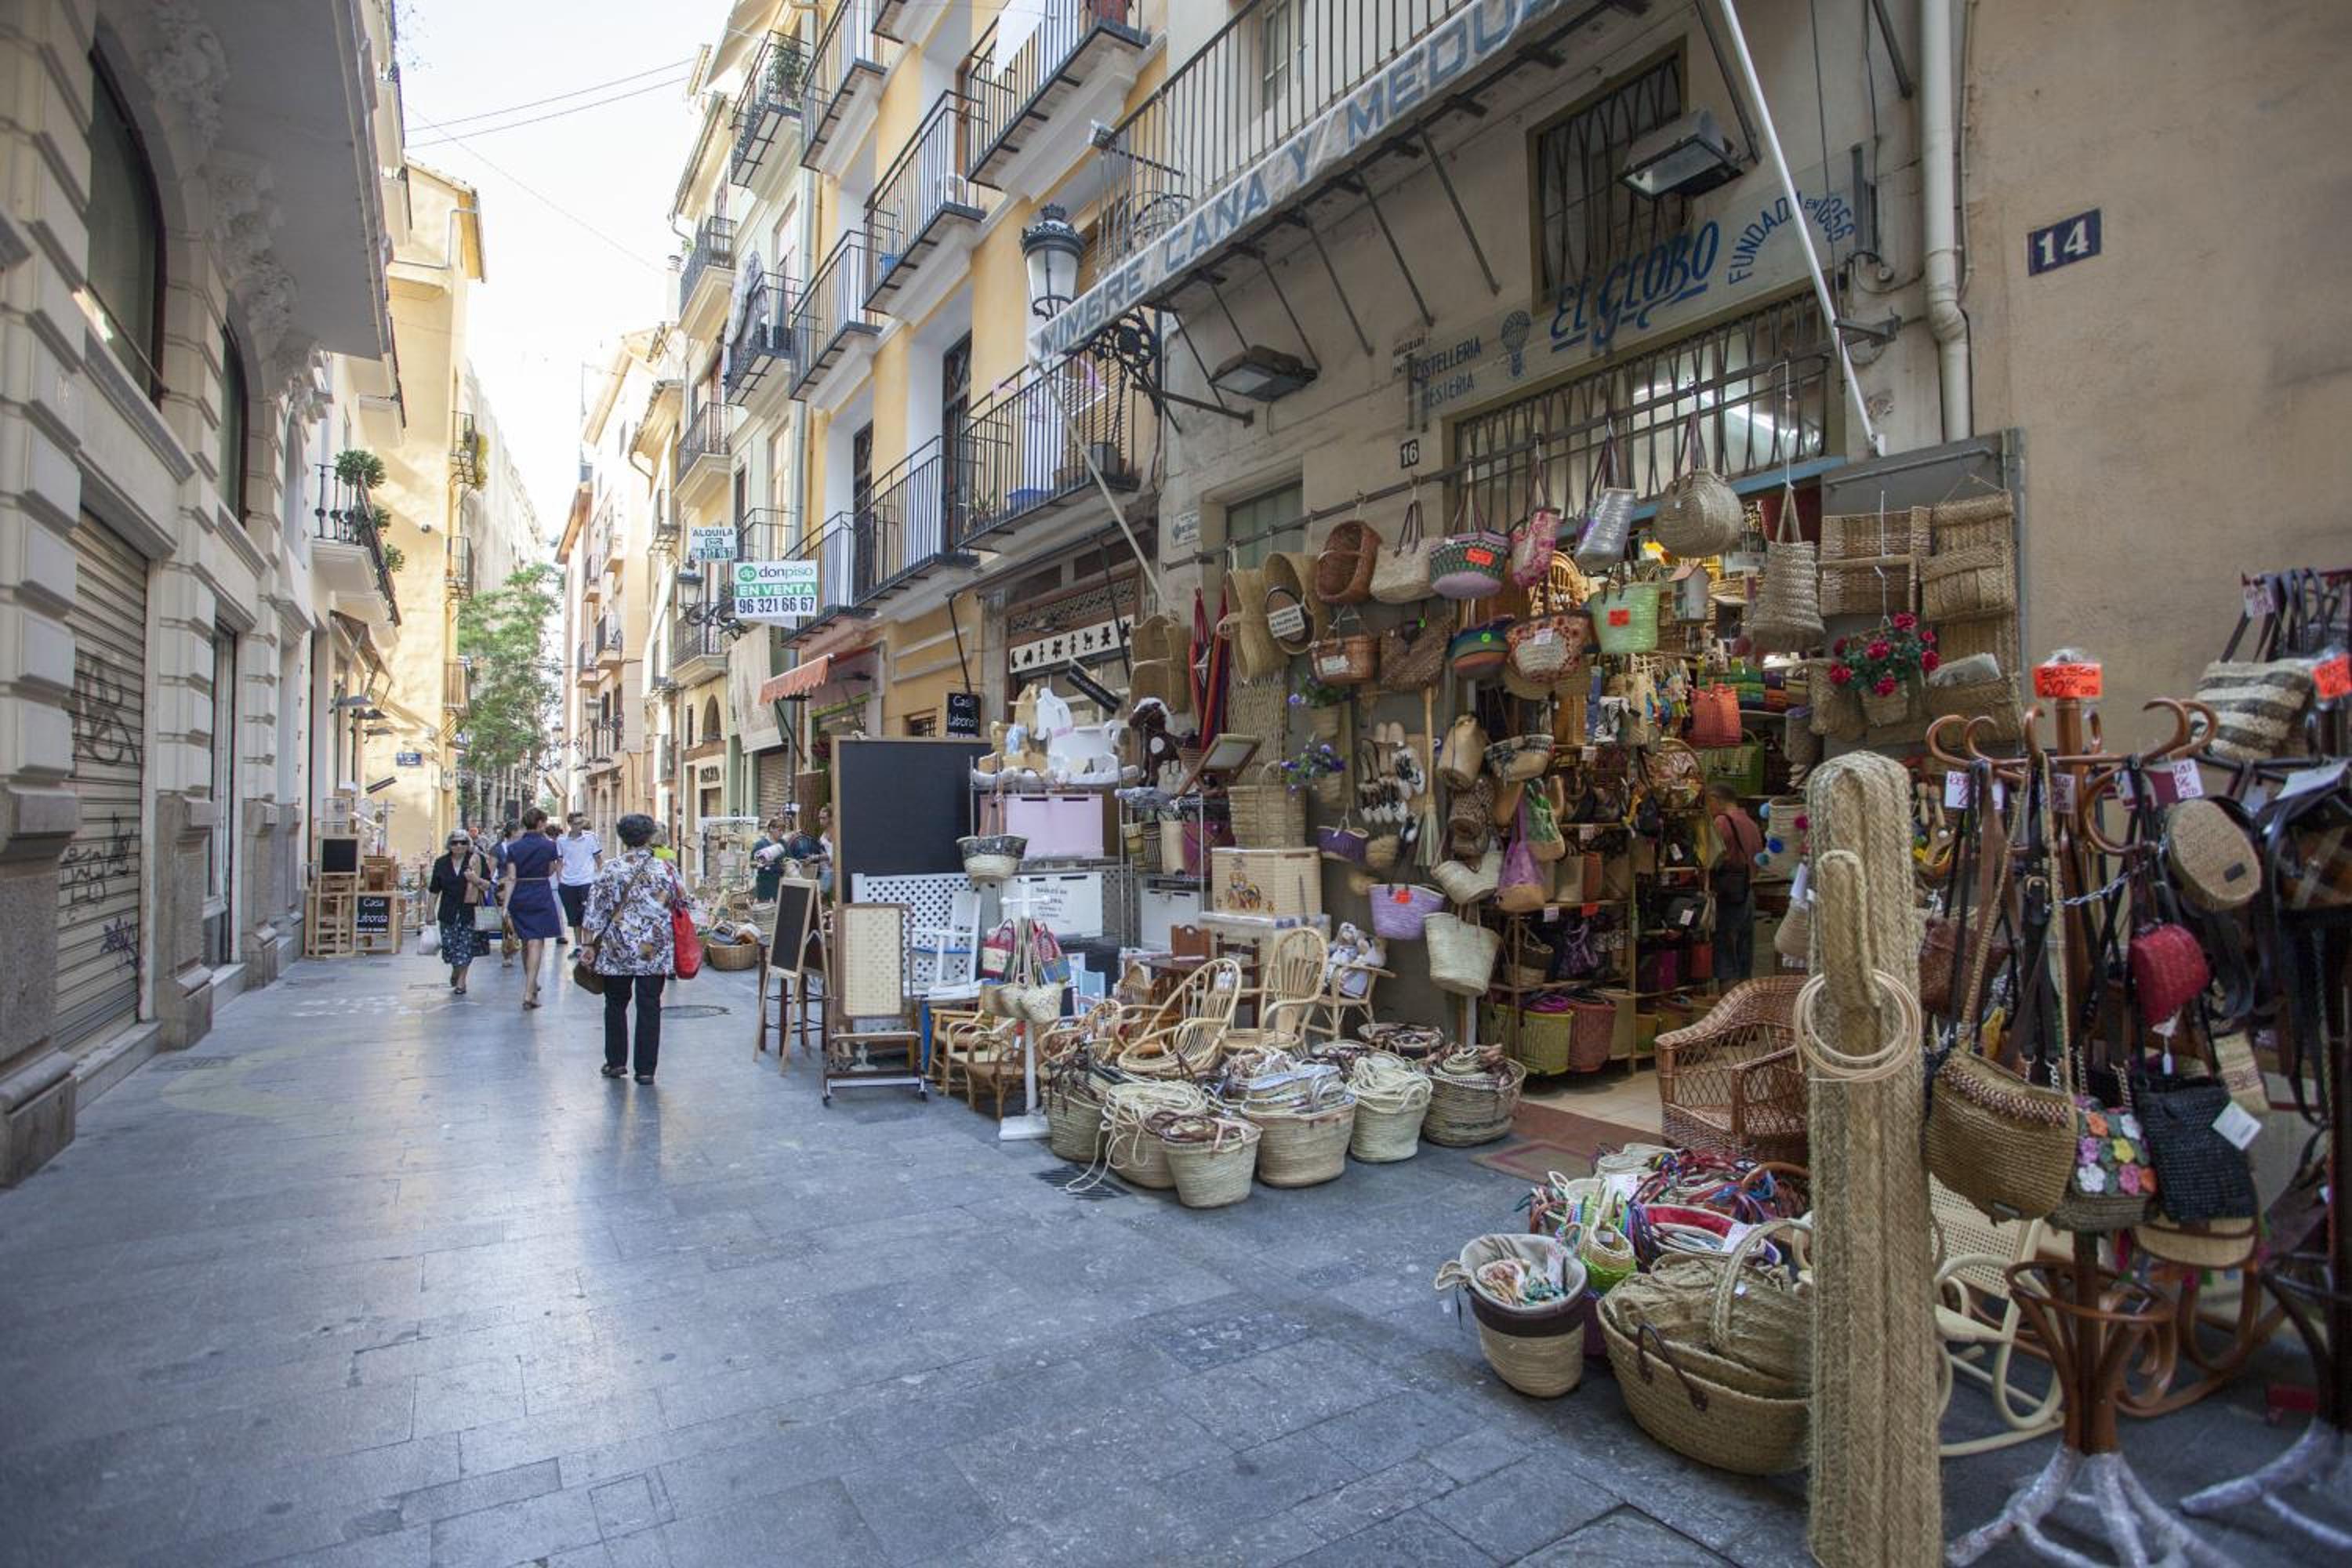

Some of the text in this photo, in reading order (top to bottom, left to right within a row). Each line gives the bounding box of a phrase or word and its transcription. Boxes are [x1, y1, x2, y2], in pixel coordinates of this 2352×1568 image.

[1040, 256, 1144, 356] MIMBRE
[1287, 130, 1312, 183] Y
[2038, 220, 2090, 266] 14
[1550, 220, 1719, 347] EL GLOBO
[1423, 372, 1475, 408] ESTERIA
[1402, 443, 1419, 466] 16
[691, 528, 734, 537] ALQUILA
[758, 565, 814, 579] donpiso
[739, 584, 813, 596] EN VENTA
[739, 597, 815, 613] 96 321 66 67
